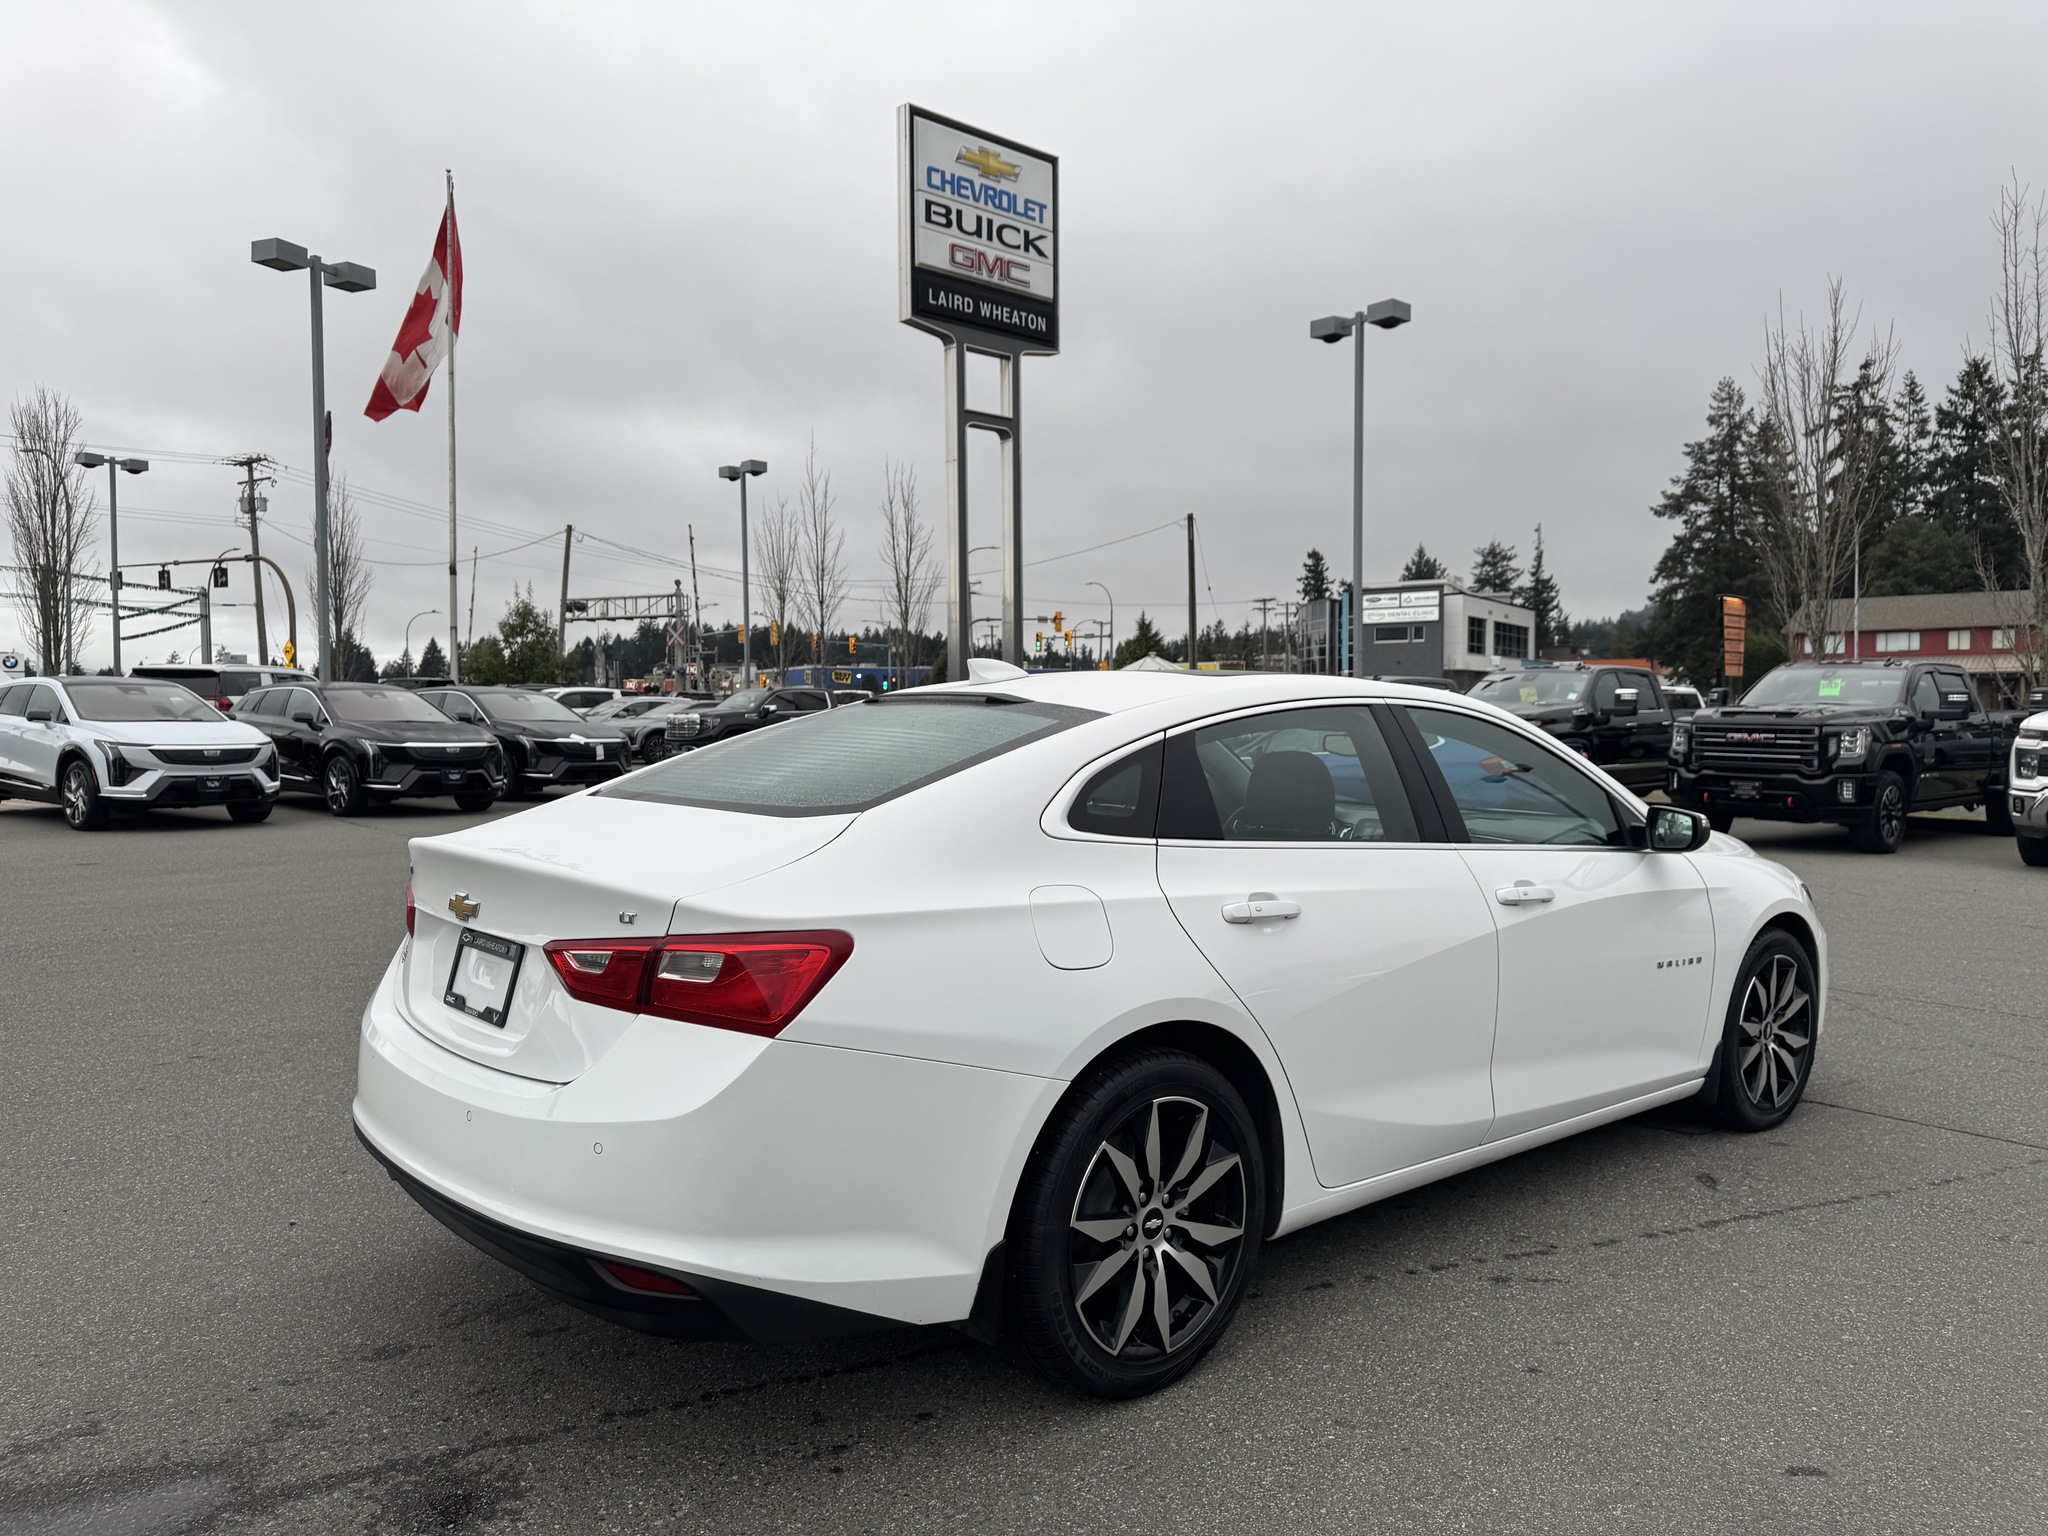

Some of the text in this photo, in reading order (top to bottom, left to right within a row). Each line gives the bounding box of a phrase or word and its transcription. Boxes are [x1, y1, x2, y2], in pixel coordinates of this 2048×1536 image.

[926, 165, 1047, 224] CHEVROLET
[924, 198, 1049, 259] BUICK
[949, 242, 1030, 288] GMC
[928, 287, 1047, 332] LAIRD WHEATON
[1726, 732, 1775, 744] GMC
[619, 911, 638, 925] LT
[1656, 956, 1702, 970] MALIBU
